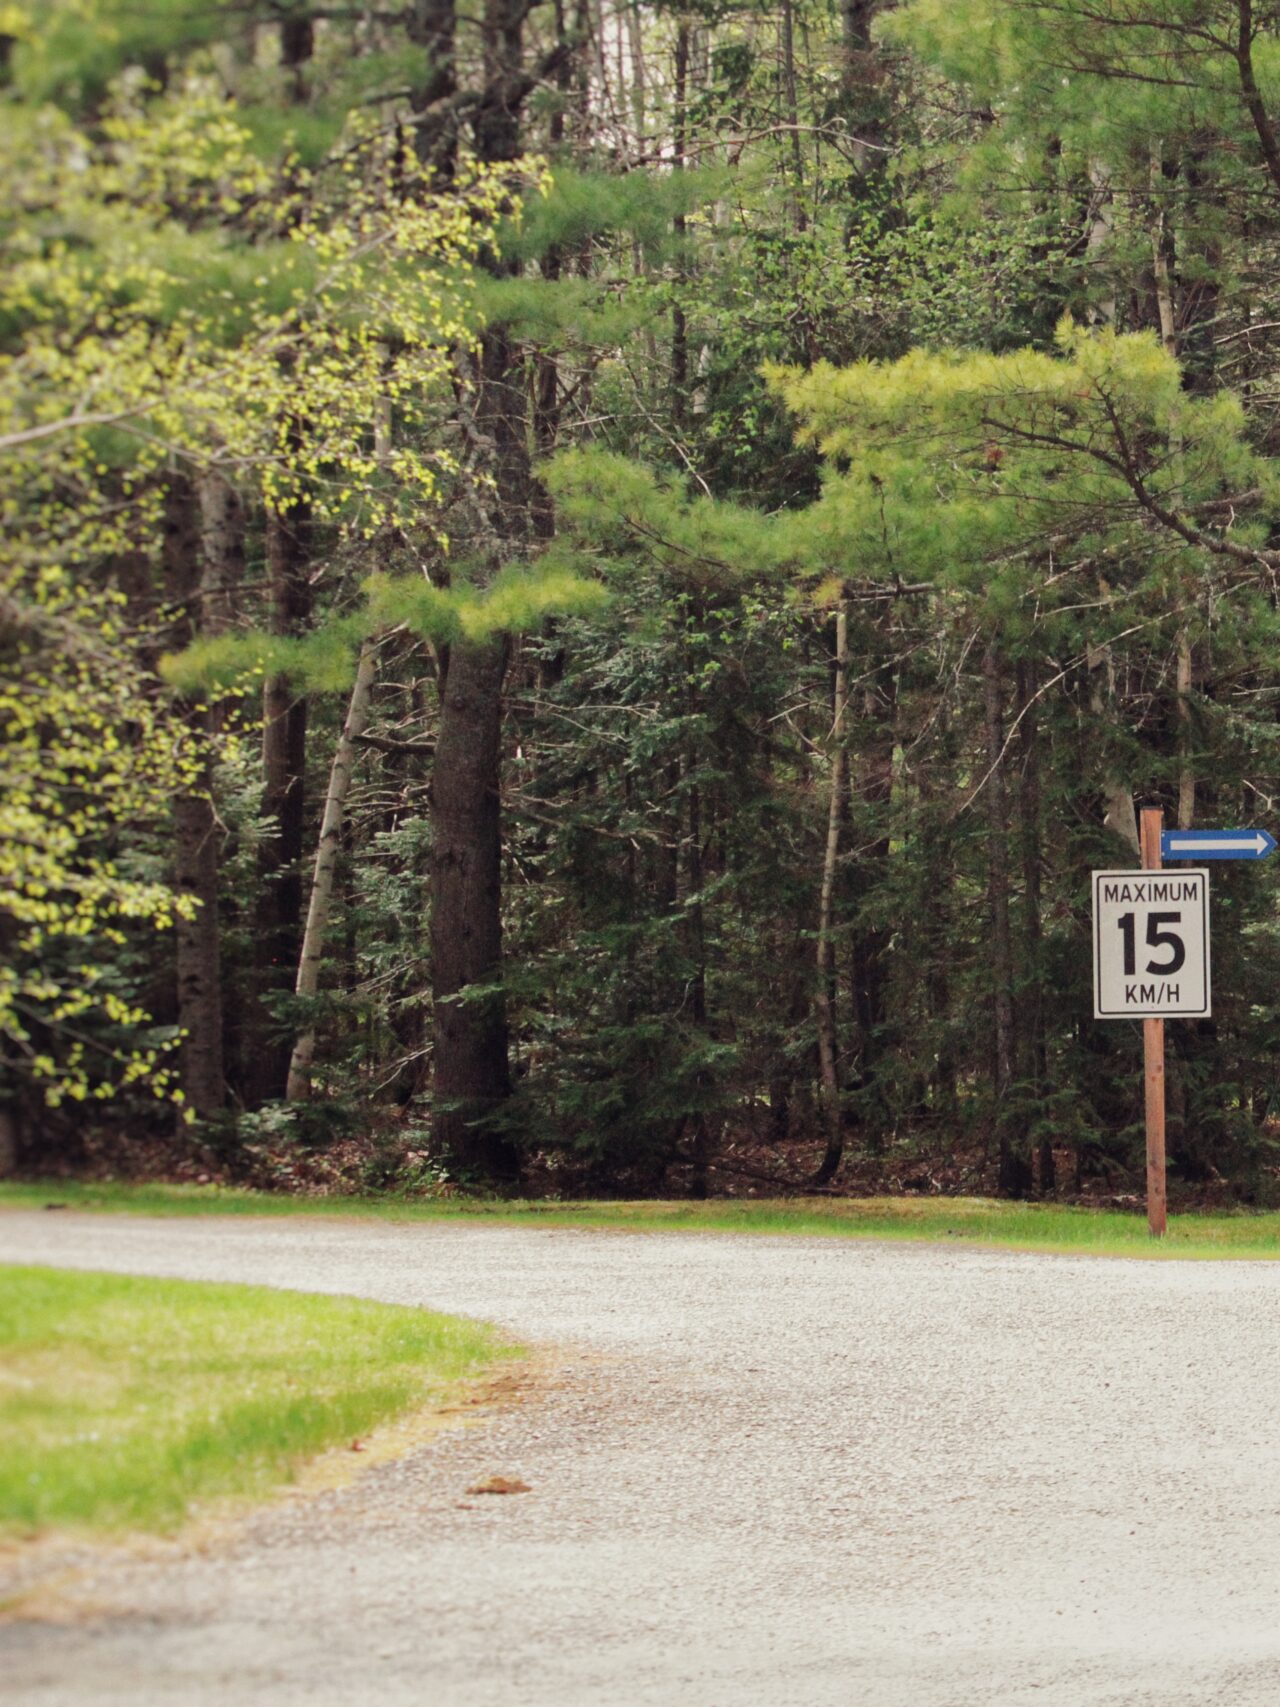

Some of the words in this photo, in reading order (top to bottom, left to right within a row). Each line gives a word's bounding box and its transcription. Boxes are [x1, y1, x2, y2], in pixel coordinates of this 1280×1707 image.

[1104, 882, 1198, 903] MAXIMUM
[1117, 911, 1186, 976] 15
[1125, 982, 1180, 1004] KM/H
